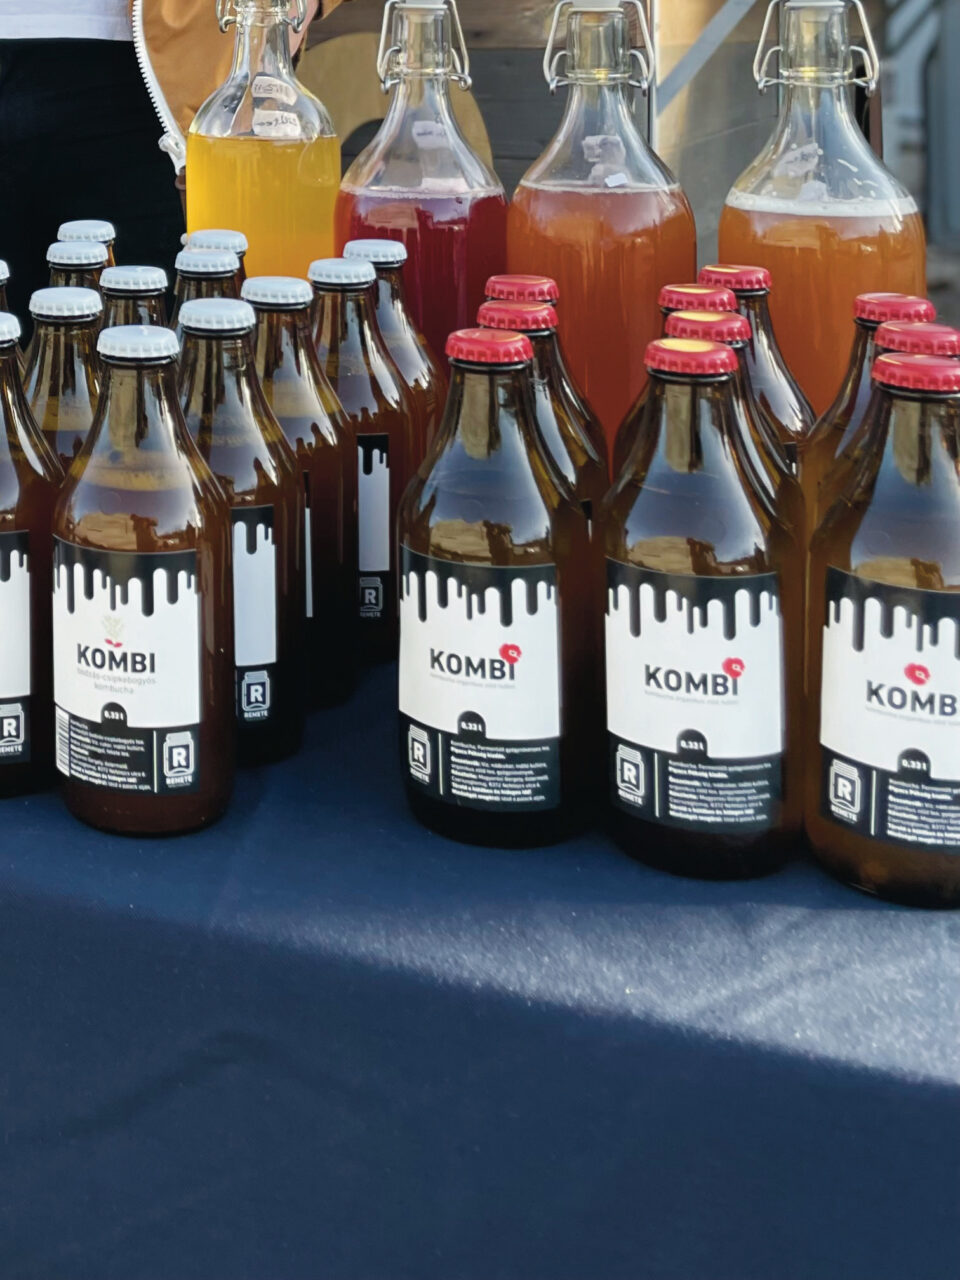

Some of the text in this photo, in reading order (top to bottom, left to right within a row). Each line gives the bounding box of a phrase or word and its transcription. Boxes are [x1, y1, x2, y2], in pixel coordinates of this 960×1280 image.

[364, 588, 376, 604] R
[77, 643, 156, 674] KOMBI
[430, 647, 515, 681] KOMBI
[644, 664, 738, 696] KOMBI
[250, 684, 263, 703] R
[866, 679, 958, 717] KOMB
[2, 718, 17, 737] R
[172, 747, 187, 767] R
[413, 740, 425, 764] R
[623, 761, 637, 786] R
[837, 777, 852, 802] R
